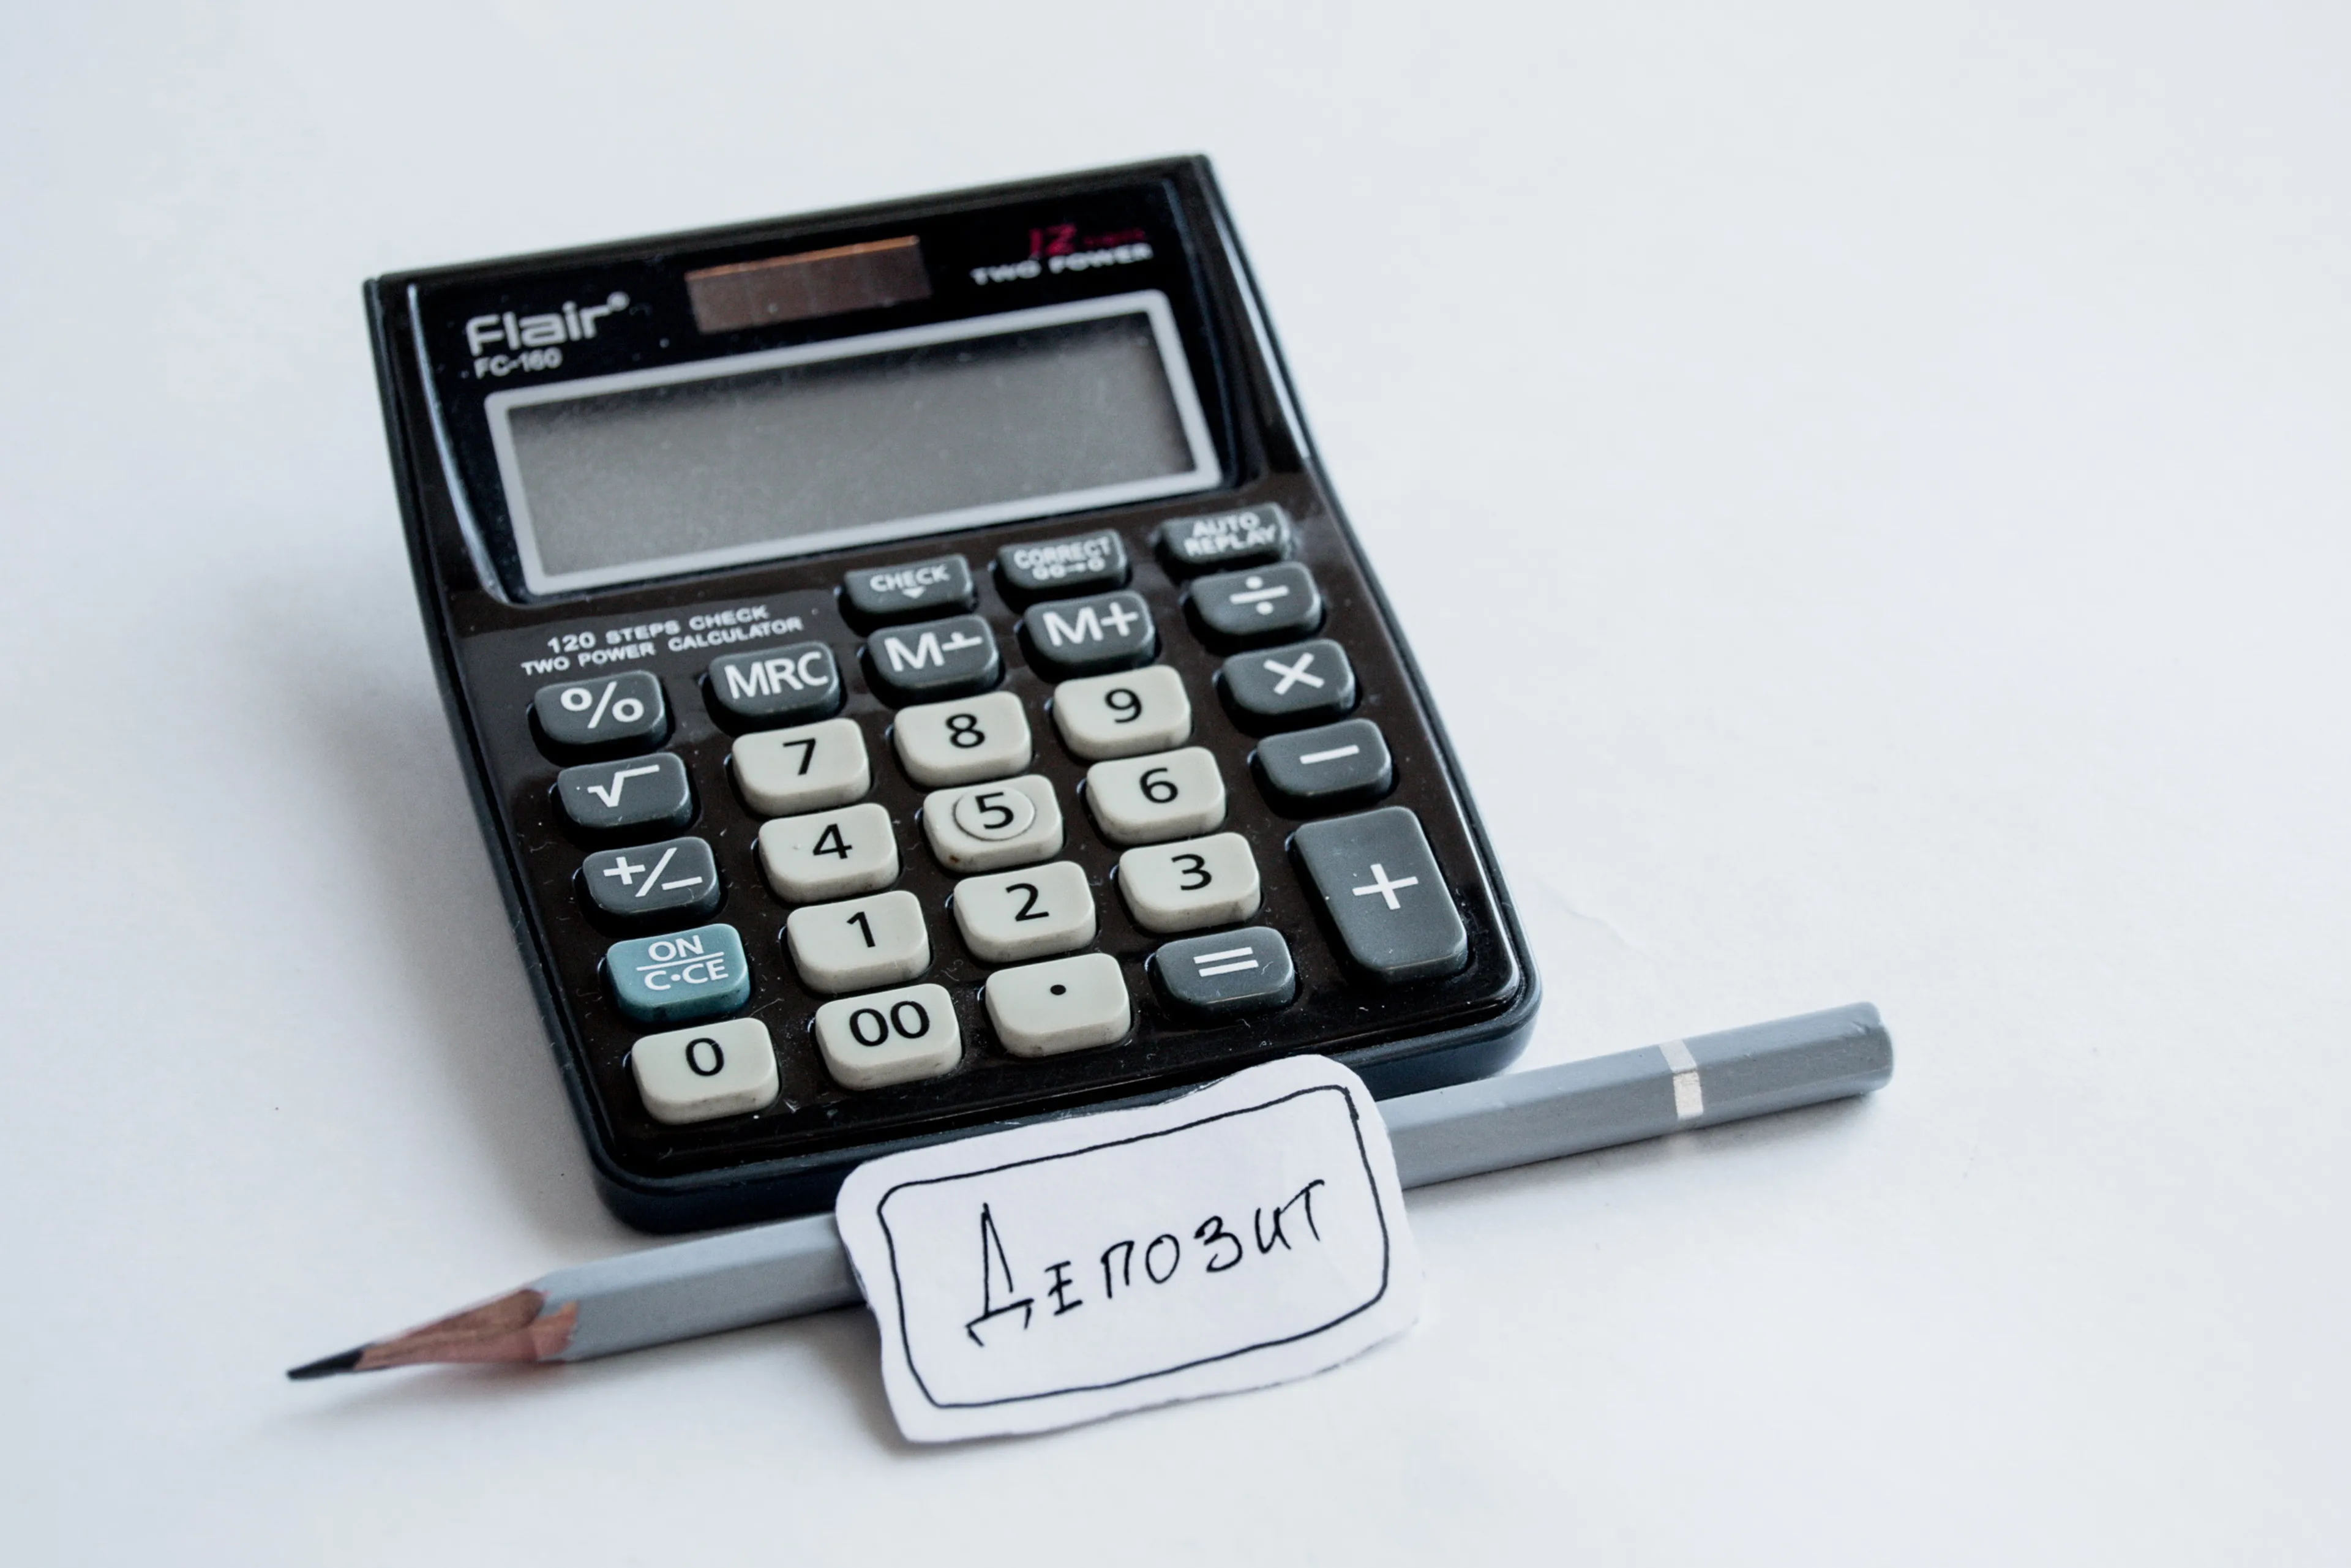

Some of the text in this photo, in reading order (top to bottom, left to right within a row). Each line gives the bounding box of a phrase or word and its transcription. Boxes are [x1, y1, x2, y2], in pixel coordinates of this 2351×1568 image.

[970, 242, 1154, 285] TWO POWER
[465, 291, 630, 357] Flair
[474, 347, 563, 380] FC-160
[1183, 523, 1277, 557] REPLAY
[1191, 512, 1260, 539] AUTO
[1013, 536, 1111, 569] CORRECT
[869, 563, 951, 592] CHECK
[547, 604, 771, 655] 120 STEPS CHECK
[1043, 601, 1139, 647] M+
[520, 616, 804, 676] TWO POWER CALCULATOR
[724, 651, 830, 700] MRC
[560, 681, 645, 729] %
[1104, 688, 1143, 724] 9
[945, 713, 986, 749] 8
[782, 737, 817, 776] 7
[1139, 767, 1179, 805] 6
[974, 791, 1014, 830] 5
[812, 823, 853, 860] 4
[1171, 853, 1213, 891] 3
[1005, 882, 1049, 922] 2
[647, 934, 707, 962] ON
[846, 910, 876, 948] 1
[849, 1000, 930, 1048] 00
[684, 1037, 725, 1077] 0
